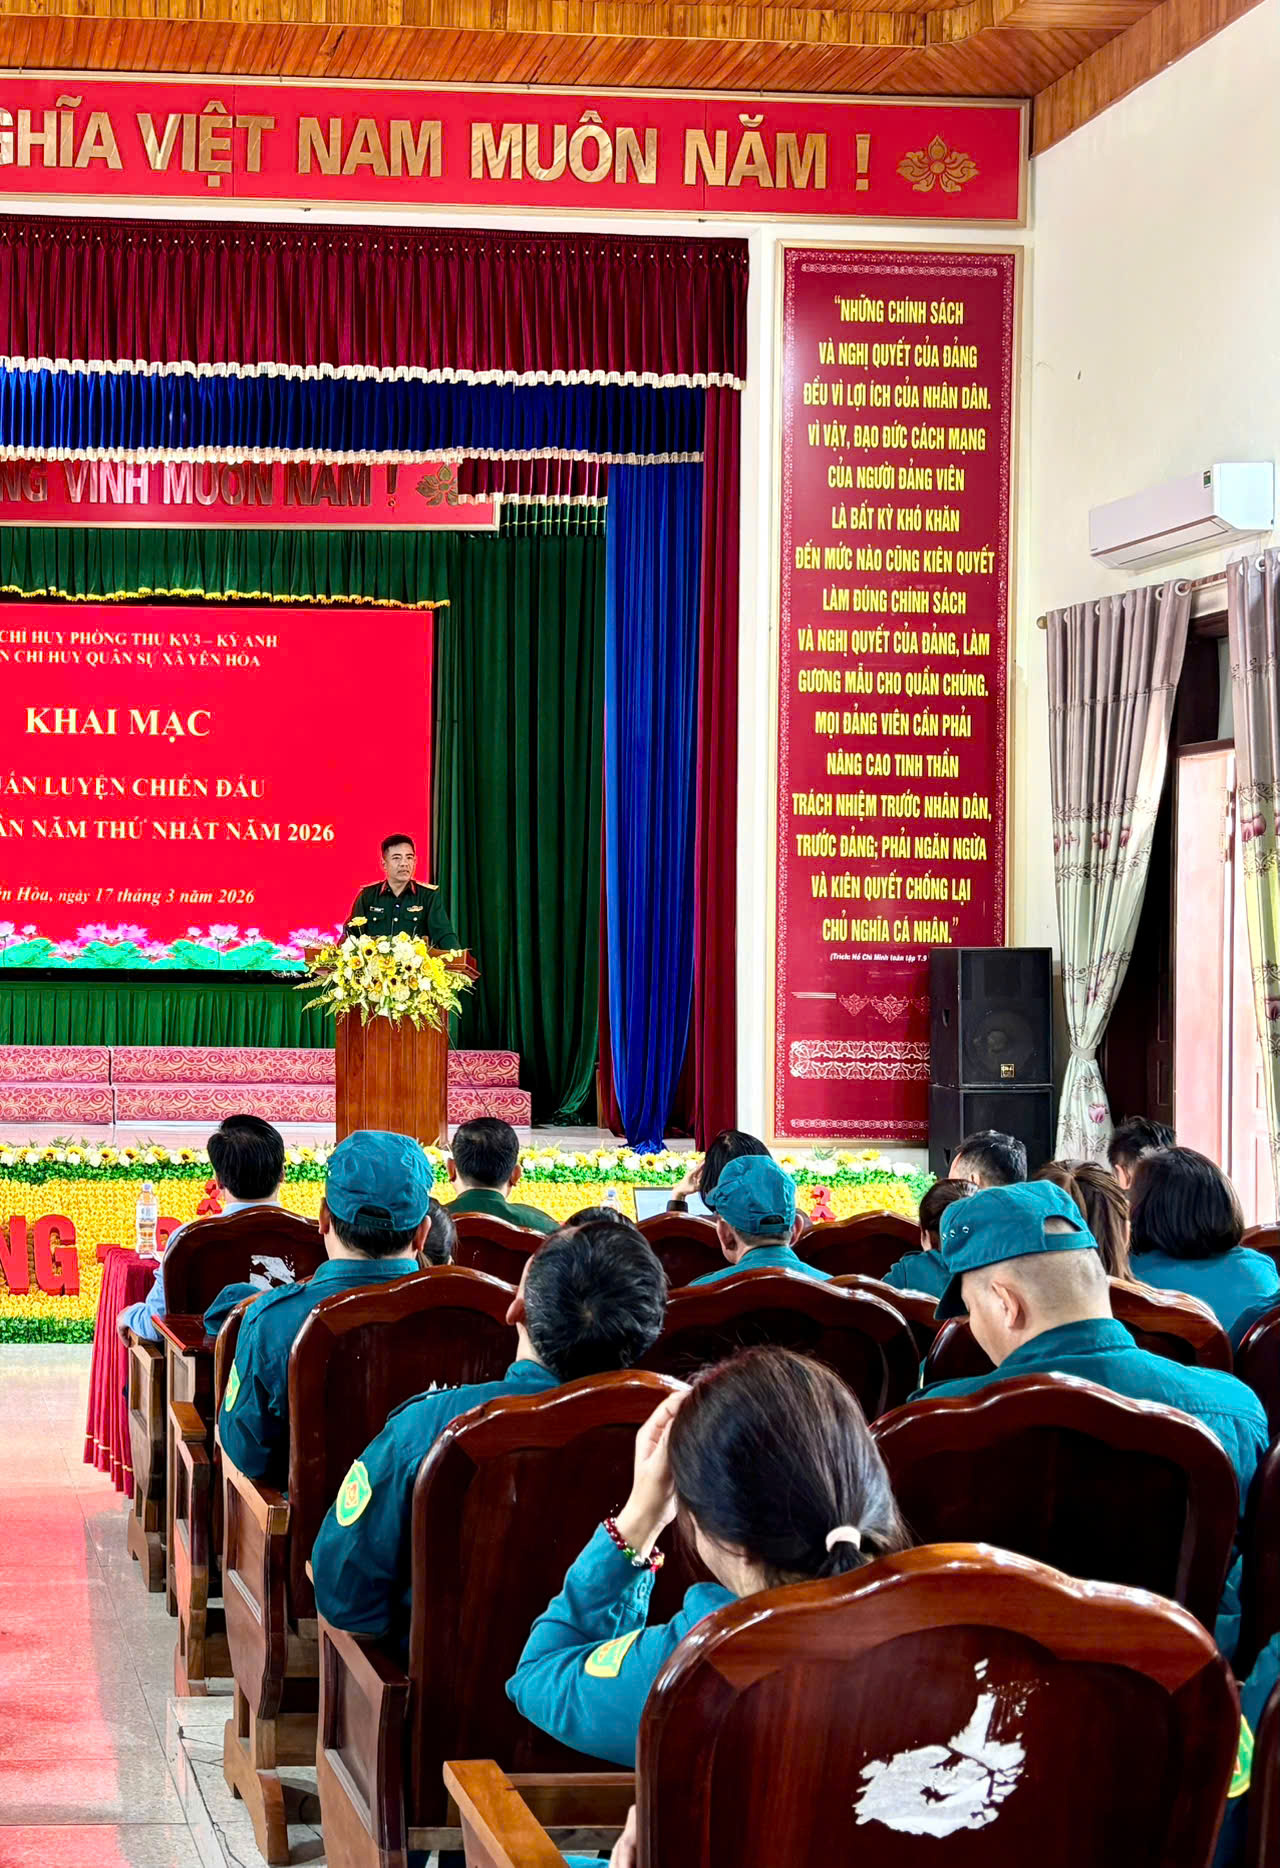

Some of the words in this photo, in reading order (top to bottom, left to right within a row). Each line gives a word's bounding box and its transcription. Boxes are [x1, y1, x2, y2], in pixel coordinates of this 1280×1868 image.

[136, 100, 274, 188] VIỆT
[297, 118, 442, 177] NAM
[470, 110, 657, 184] MUÔN
[683, 113, 827, 190] NĂM
[854, 133, 870, 192] !
[888, 295, 927, 324] CHÍNH
[930, 297, 964, 325] SÁCH
[818, 337, 836, 365] VÀ
[838, 342, 869, 371] NGHỊ
[871, 336, 912, 369] QUYẾT
[914, 335, 940, 368] CỦA
[942, 336, 978, 369] ĐẢNG
[802, 374, 828, 406] ĐỀU
[831, 378, 844, 406] VÌ
[847, 382, 866, 412] LỢI
[869, 379, 891, 408] ÍCH
[894, 375, 920, 408] CỦA
[923, 381, 958, 409] NHÂN
[961, 382, 991, 410] DÂN.
[807, 418, 821, 447] VÌ
[822, 419, 851, 452] VẬY,
[853, 424, 880, 453] ĐẠO
[881, 419, 908, 449] ĐỨC
[911, 422, 945, 450] CÁCH
[948, 427, 986, 455] MẠNG
[65, 460, 150, 504] VINH
[827, 455, 853, 489] CỦA
[856, 460, 895, 490] NGƯỜI
[898, 457, 933, 491] ĐẢNG
[936, 463, 965, 491] VIÊN
[831, 502, 848, 529] LÀ
[850, 499, 875, 530] BẤT
[877, 503, 894, 531] KỲ
[896, 503, 922, 532] KHÓ
[925, 505, 960, 532] KHĂN
[32, 631, 65, 645] HUY
[244, 635, 278, 649] ANH
[48, 650, 82, 665] HUY
[25, 706, 119, 736] KHAI
[128, 709, 212, 744] MẠC
[32, 816, 87, 839] NĂM
[225, 818, 281, 841] NĂM
[288, 822, 336, 842] 2026
[58, 890, 91, 905] ngày
[95, 888, 114, 902] 17
[165, 888, 176, 903] 3
[179, 890, 213, 904] năm
[217, 889, 257, 904] 2026
